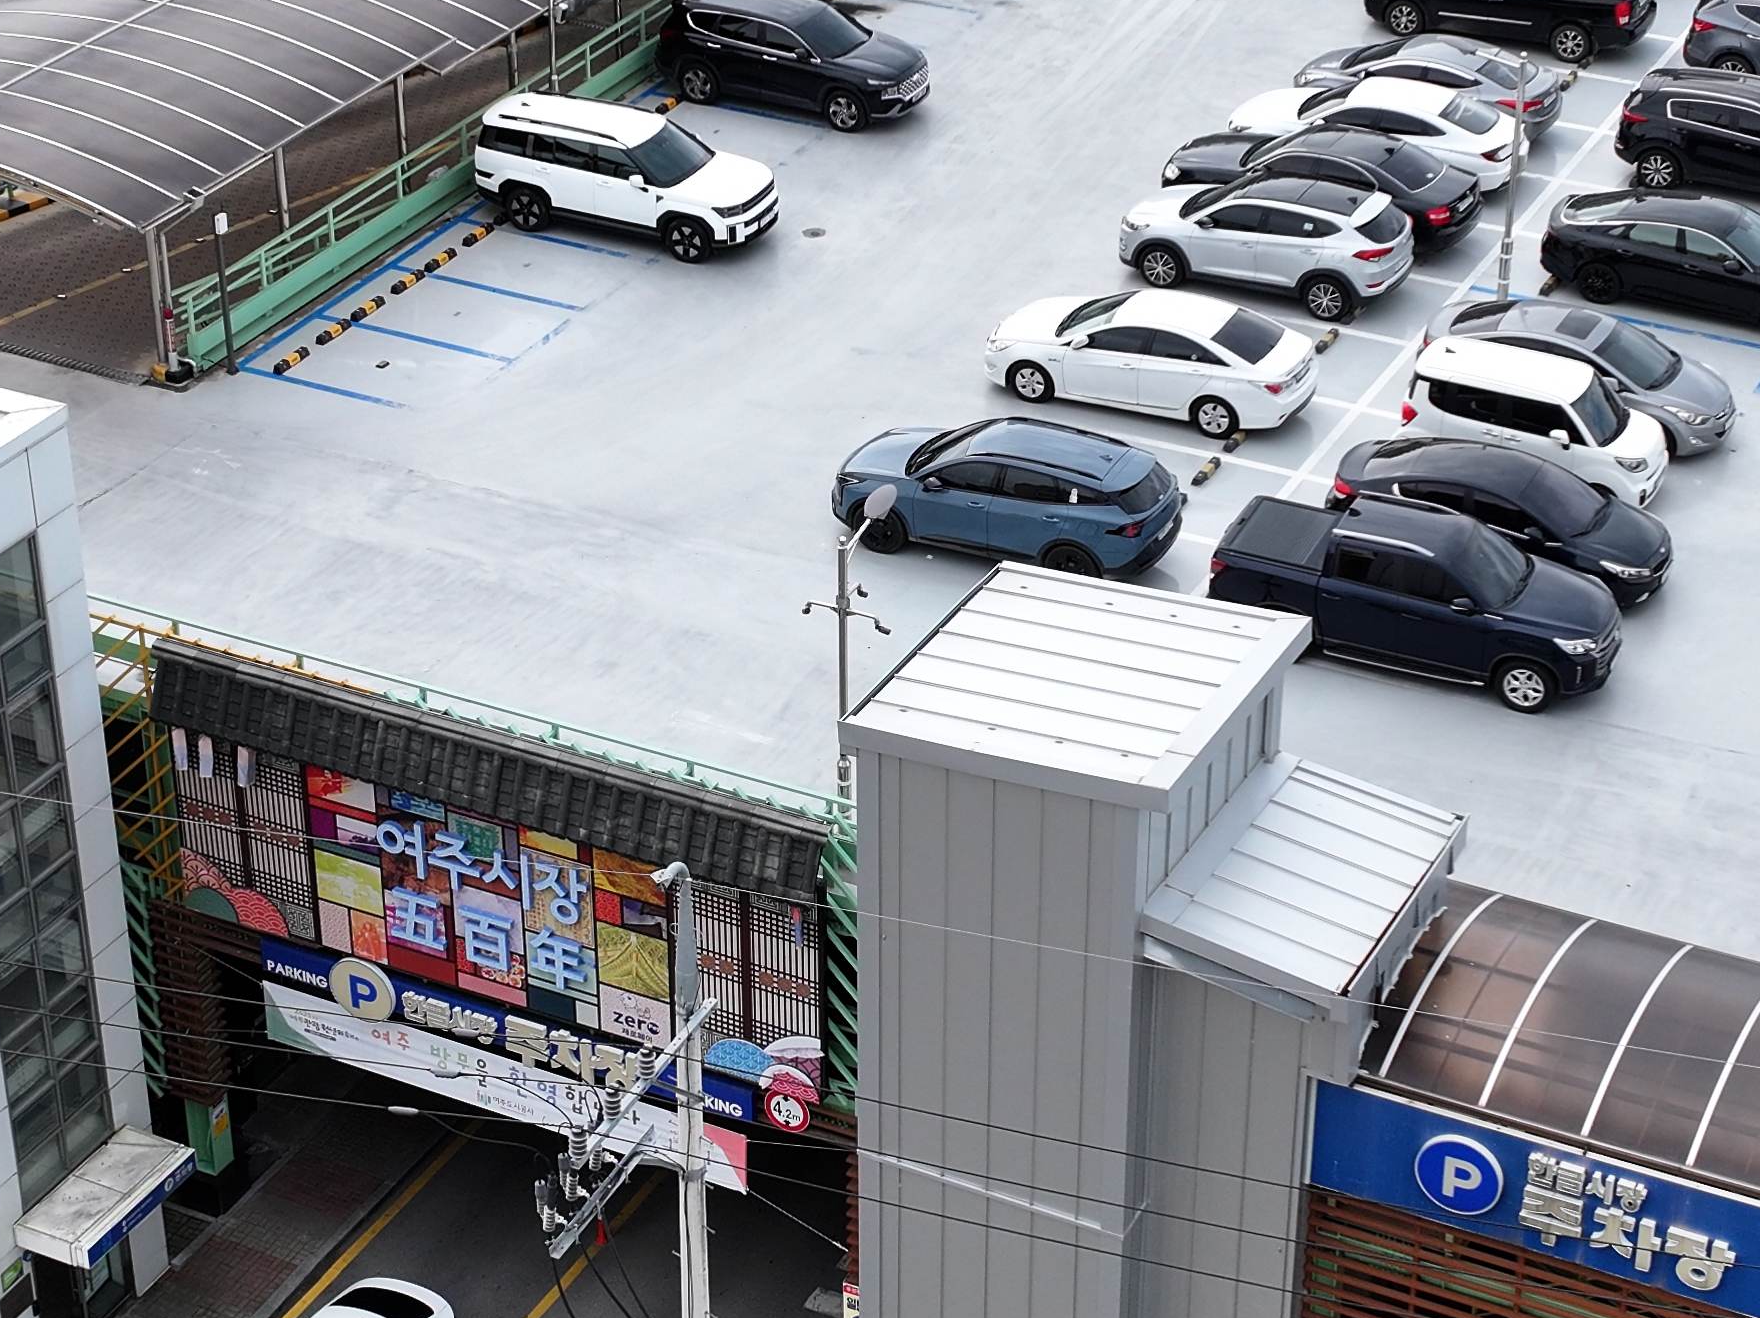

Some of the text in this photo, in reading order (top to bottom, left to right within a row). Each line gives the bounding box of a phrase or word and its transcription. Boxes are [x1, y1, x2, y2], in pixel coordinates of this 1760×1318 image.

[377, 820, 588, 925] 여주시장
[390, 886, 588, 990] 五百年
[267, 960, 328, 988] PARKING
[349, 974, 378, 1009] P
[371, 1029, 410, 1051] 여주
[401, 991, 499, 1045] 한글시장
[504, 1015, 640, 1094] 주차장
[492, 1097, 534, 1116] 여주도시공사
[704, 1096, 743, 1117] KING
[773, 1101, 801, 1122] 4.2m
[1442, 1155, 1483, 1199] P
[1527, 1152, 1647, 1213] 한글시장
[1519, 1185, 1737, 1291] 주차장
